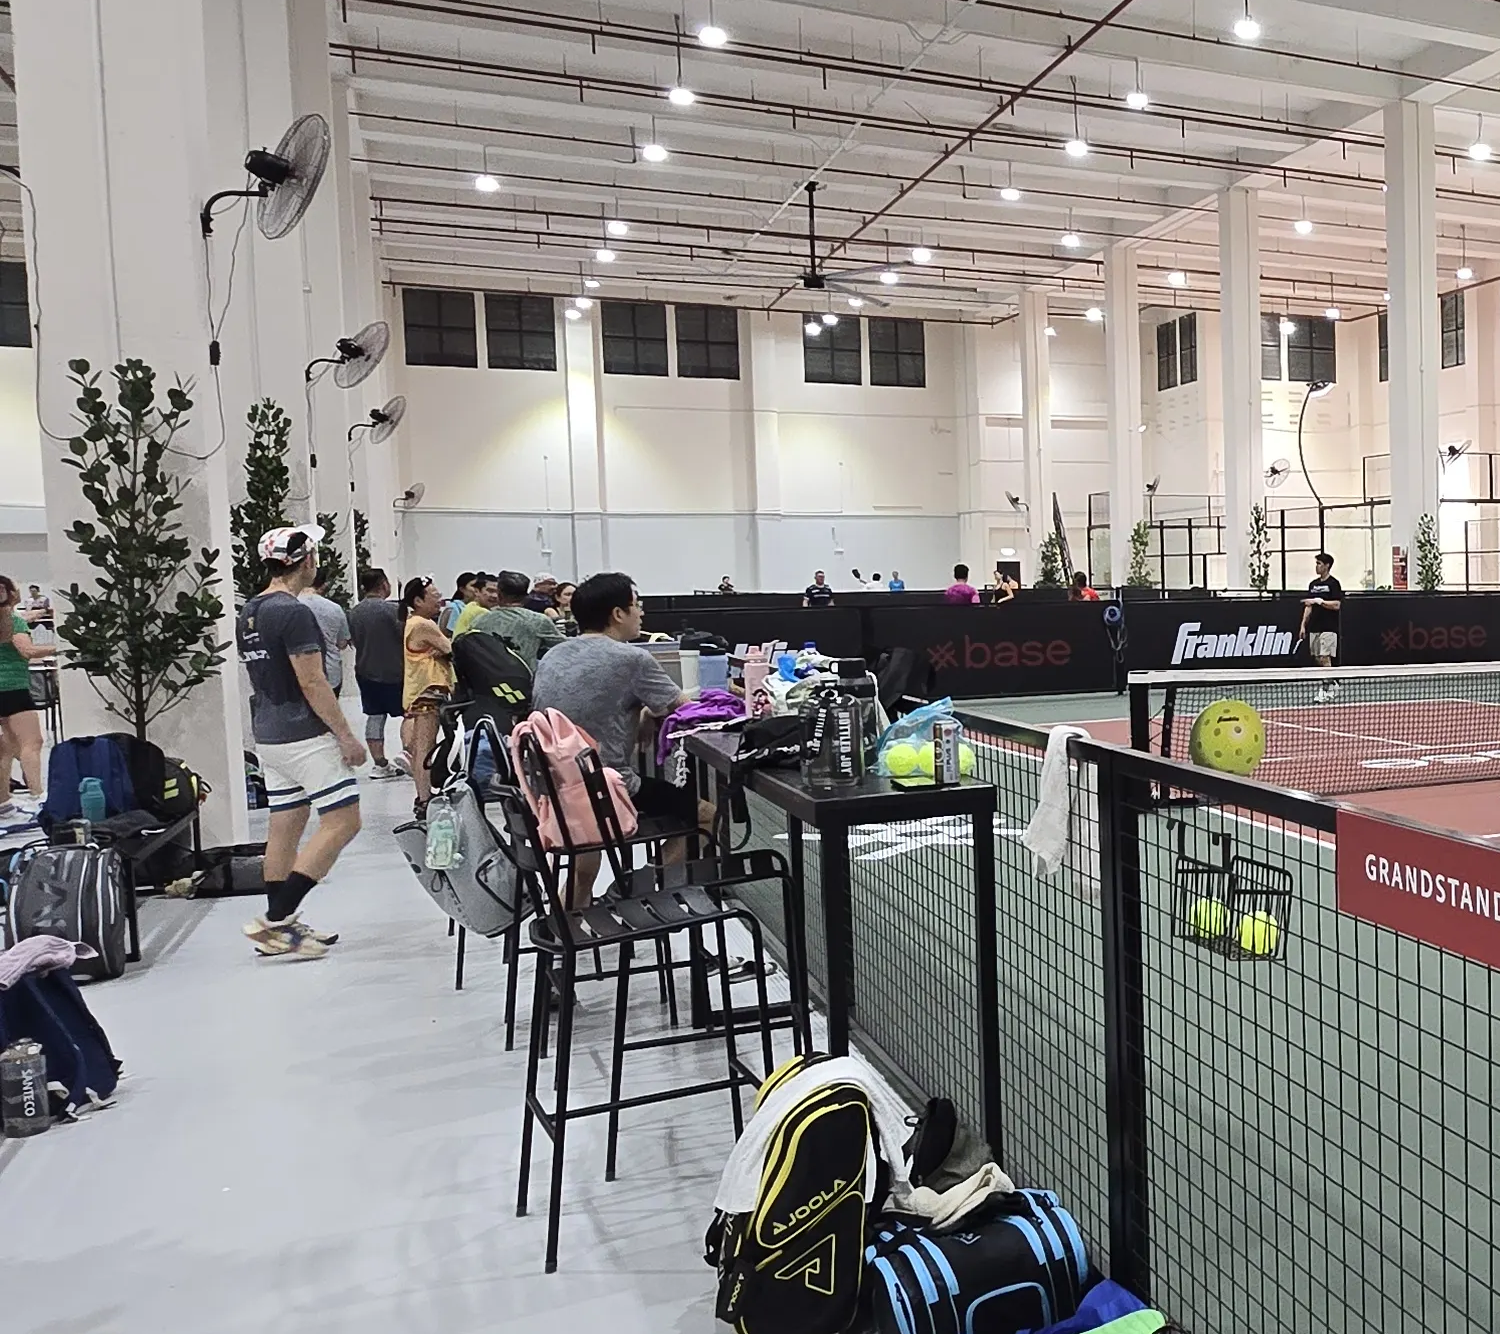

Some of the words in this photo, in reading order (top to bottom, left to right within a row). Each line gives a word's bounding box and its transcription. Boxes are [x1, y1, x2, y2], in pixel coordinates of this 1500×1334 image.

[965, 634, 1072, 668] base
[1408, 620, 1488, 651] base
[21, 1068, 36, 1117] SANTECO
[788, 1179, 847, 1227] JOOLA
